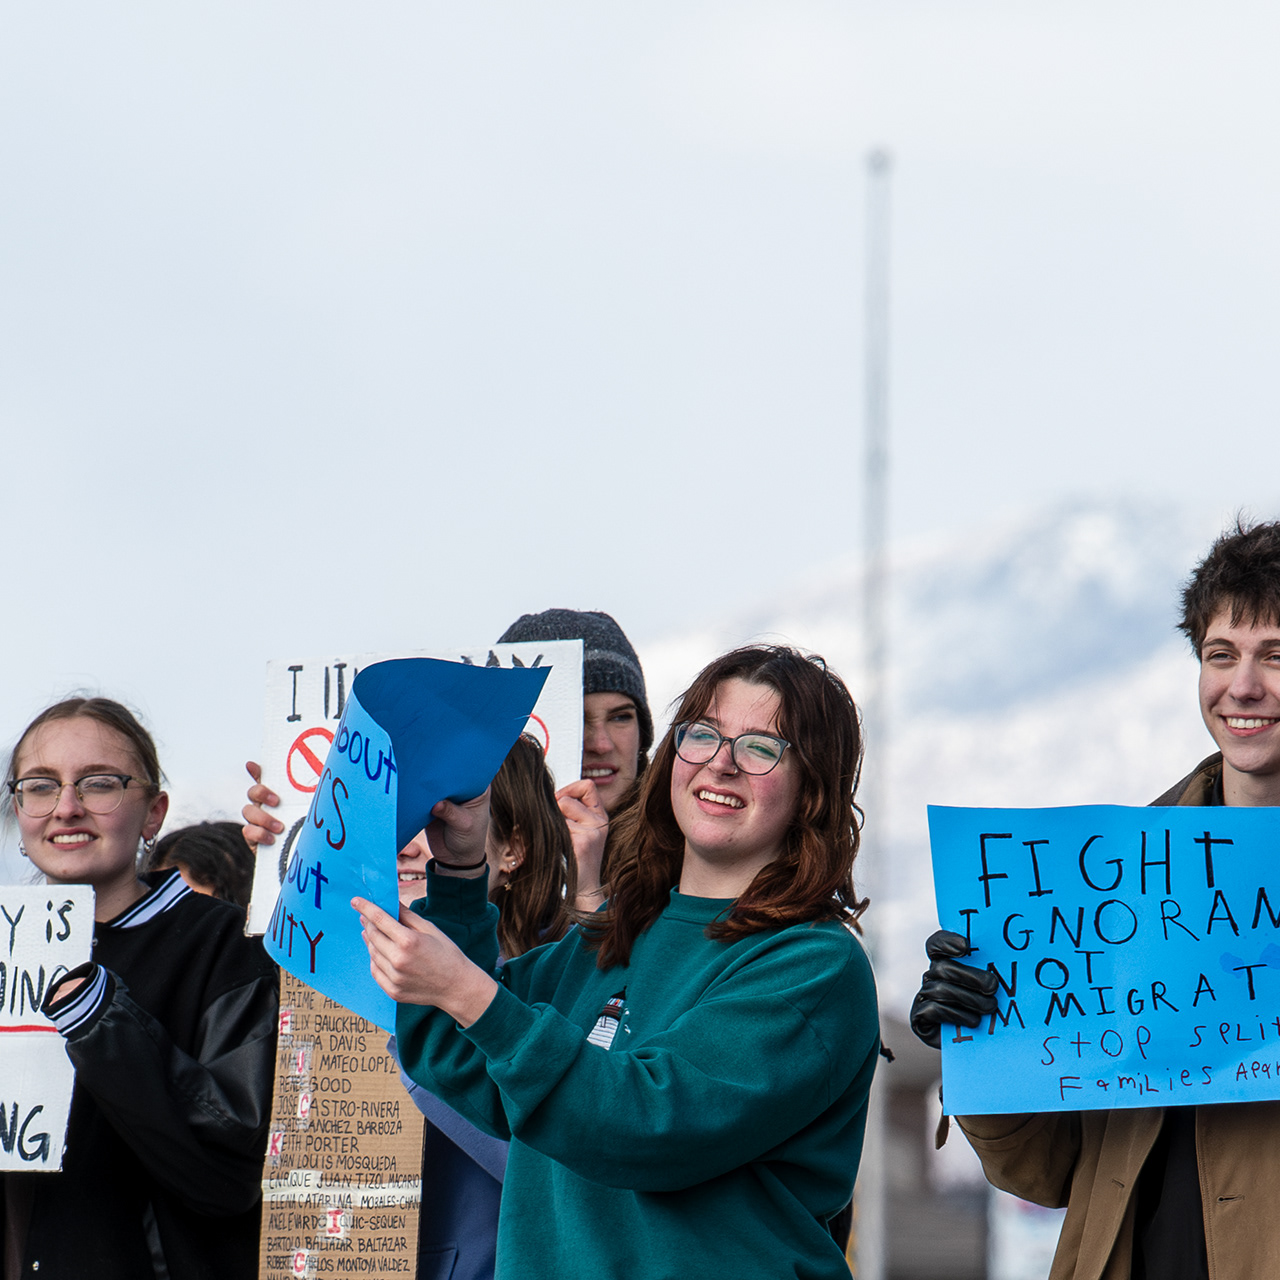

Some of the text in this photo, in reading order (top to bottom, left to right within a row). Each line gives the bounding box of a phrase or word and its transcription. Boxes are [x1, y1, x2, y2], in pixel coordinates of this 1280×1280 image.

[978, 829, 1234, 908] FIGHT
[986, 949, 1105, 998] NOT
[286, 991, 315, 1010] JAIME
[279, 1010, 309, 1036] FELIX
[329, 1035, 366, 1052] DAVIS
[319, 1055, 358, 1073] MATEO
[361, 1056, 397, 1074] LOPEZ
[309, 1075, 351, 1093] GOOD
[278, 1093, 400, 1119] JOSE CASTRO-RIVERA
[357, 1120, 402, 1135] BARBOZA
[269, 1132, 359, 1157] KEITH PORTER
[297, 1154, 333, 1169] LOUIS
[336, 1155, 397, 1172] MOSQUEDA
[270, 1171, 420, 1189] ENRIQUE JUAN TIZOL MACARIO
[270, 1194, 296, 1210] ELENA
[298, 1193, 353, 1210] CATARINA
[305, 1236, 354, 1252] BALTAZAR
[358, 1237, 407, 1252] BALTAZAR
[337, 1257, 376, 1274] MONTOYA
[378, 1256, 410, 1272] VALDEZ
